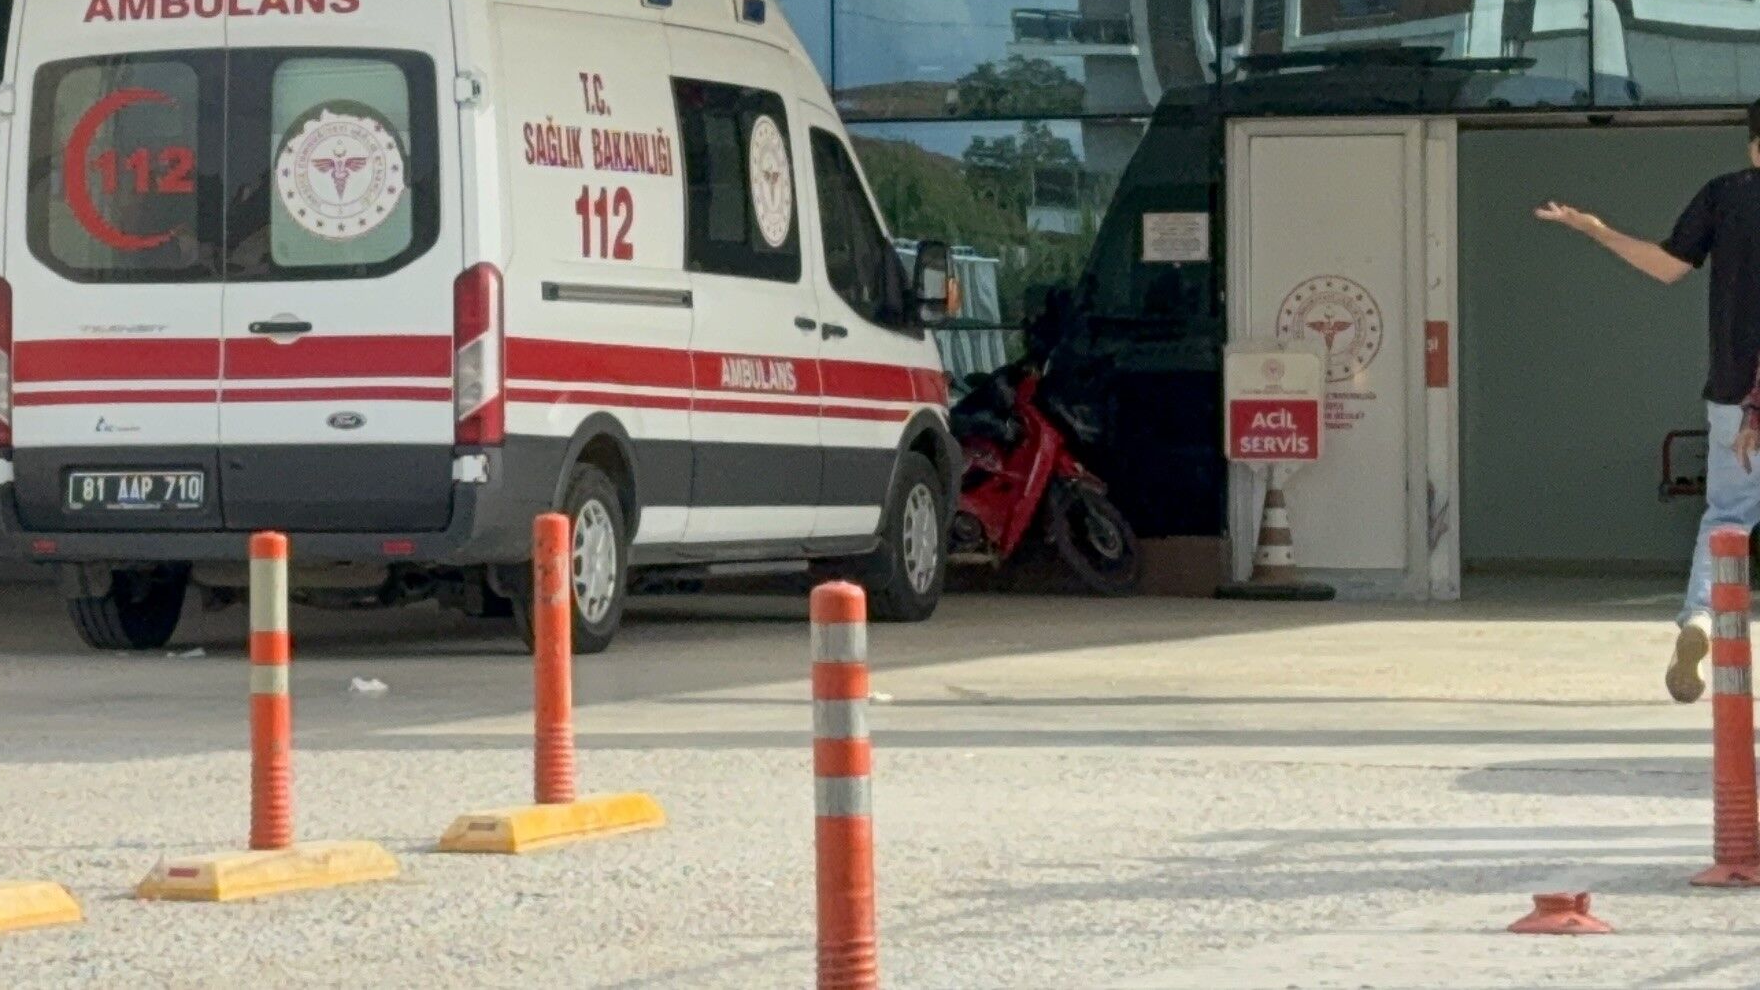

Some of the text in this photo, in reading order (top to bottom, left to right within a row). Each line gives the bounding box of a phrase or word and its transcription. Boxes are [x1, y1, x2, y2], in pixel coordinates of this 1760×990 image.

[578, 72, 611, 116] T.C.
[523, 115, 673, 176] SAĞLIK BAKANLIĞI
[91, 146, 195, 195] 112
[575, 184, 634, 260] 112
[721, 356, 797, 393] AMBULANS
[1251, 408, 1297, 429] ACİL
[1240, 431, 1309, 453] SERVİS
[82, 475, 200, 502] 81 AAP 710
